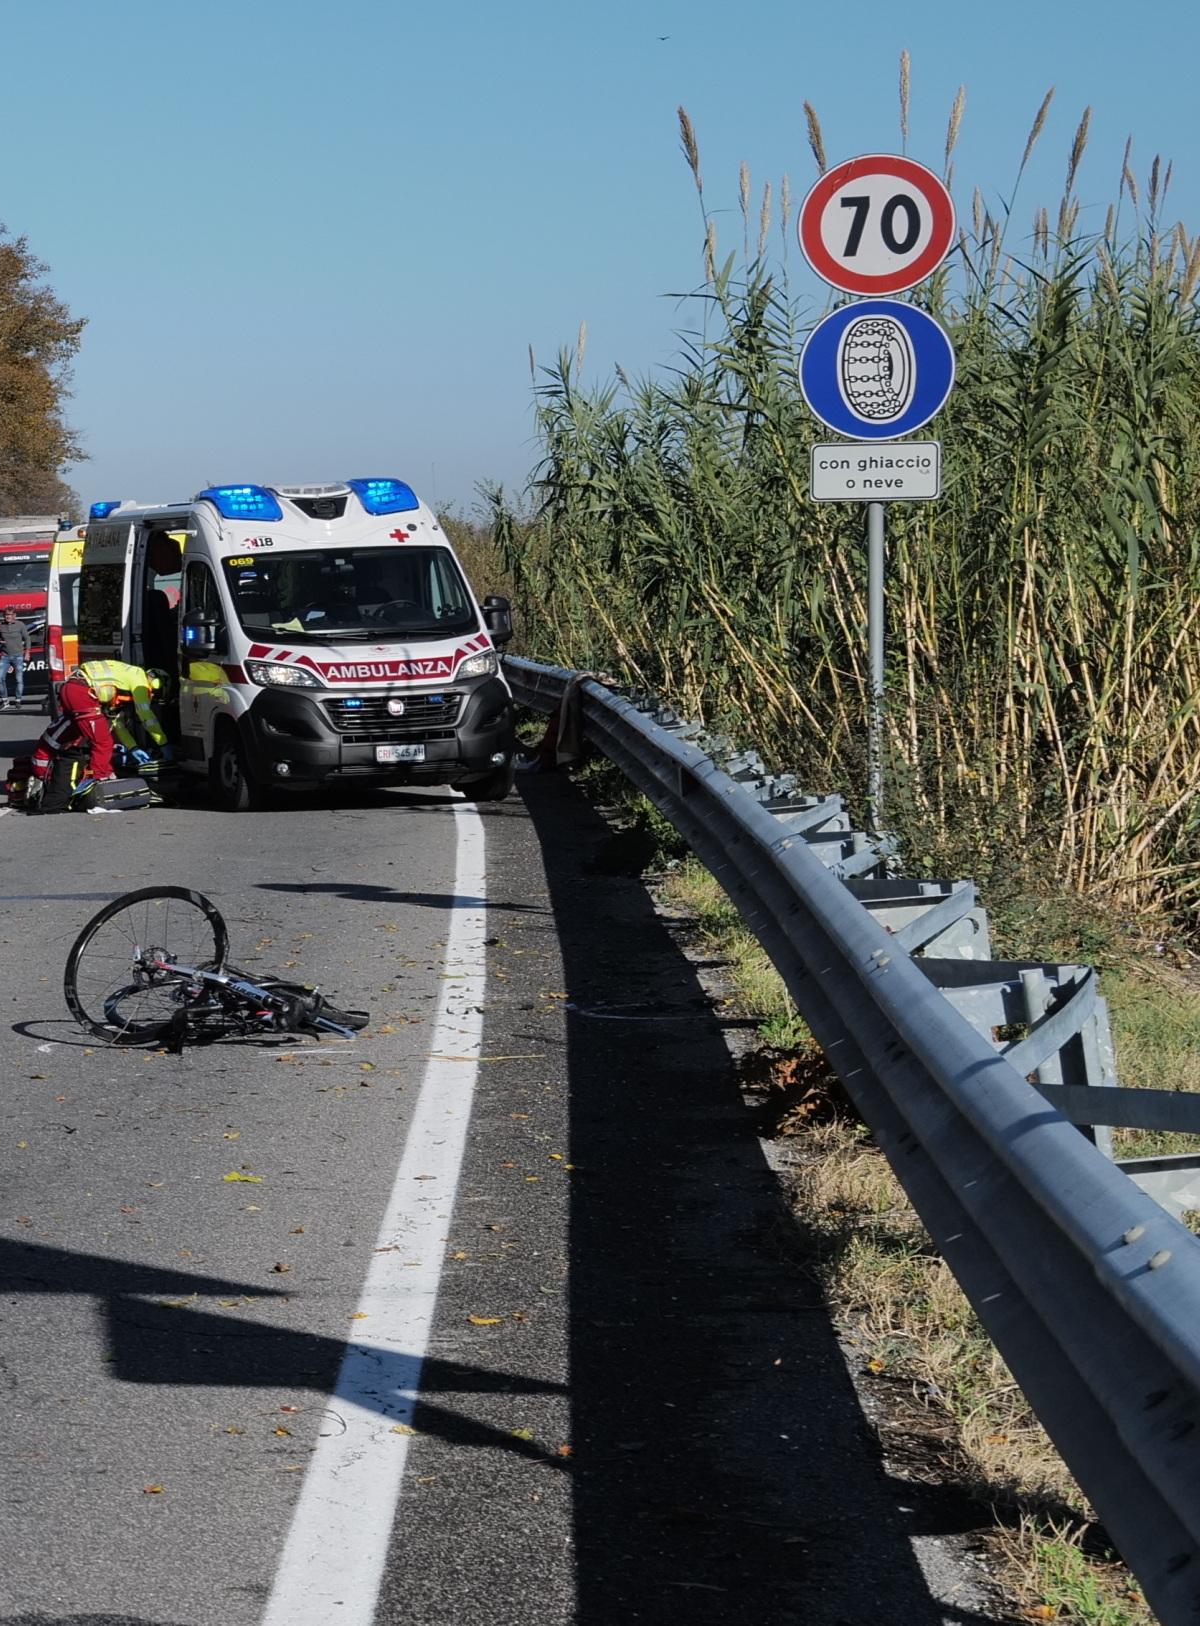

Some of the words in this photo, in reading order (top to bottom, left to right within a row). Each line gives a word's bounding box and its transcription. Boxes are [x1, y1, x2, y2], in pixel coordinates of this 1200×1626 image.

[840, 193, 921, 257] 70
[819, 456, 850, 471] con
[857, 455, 931, 472] ghiaccio
[845, 479, 856, 489] o
[862, 478, 904, 490] neve
[254, 537, 274, 547] 118
[229, 556, 254, 567] 069
[22, 660, 49, 672] CAR
[326, 660, 451, 679] AMBULANZA
